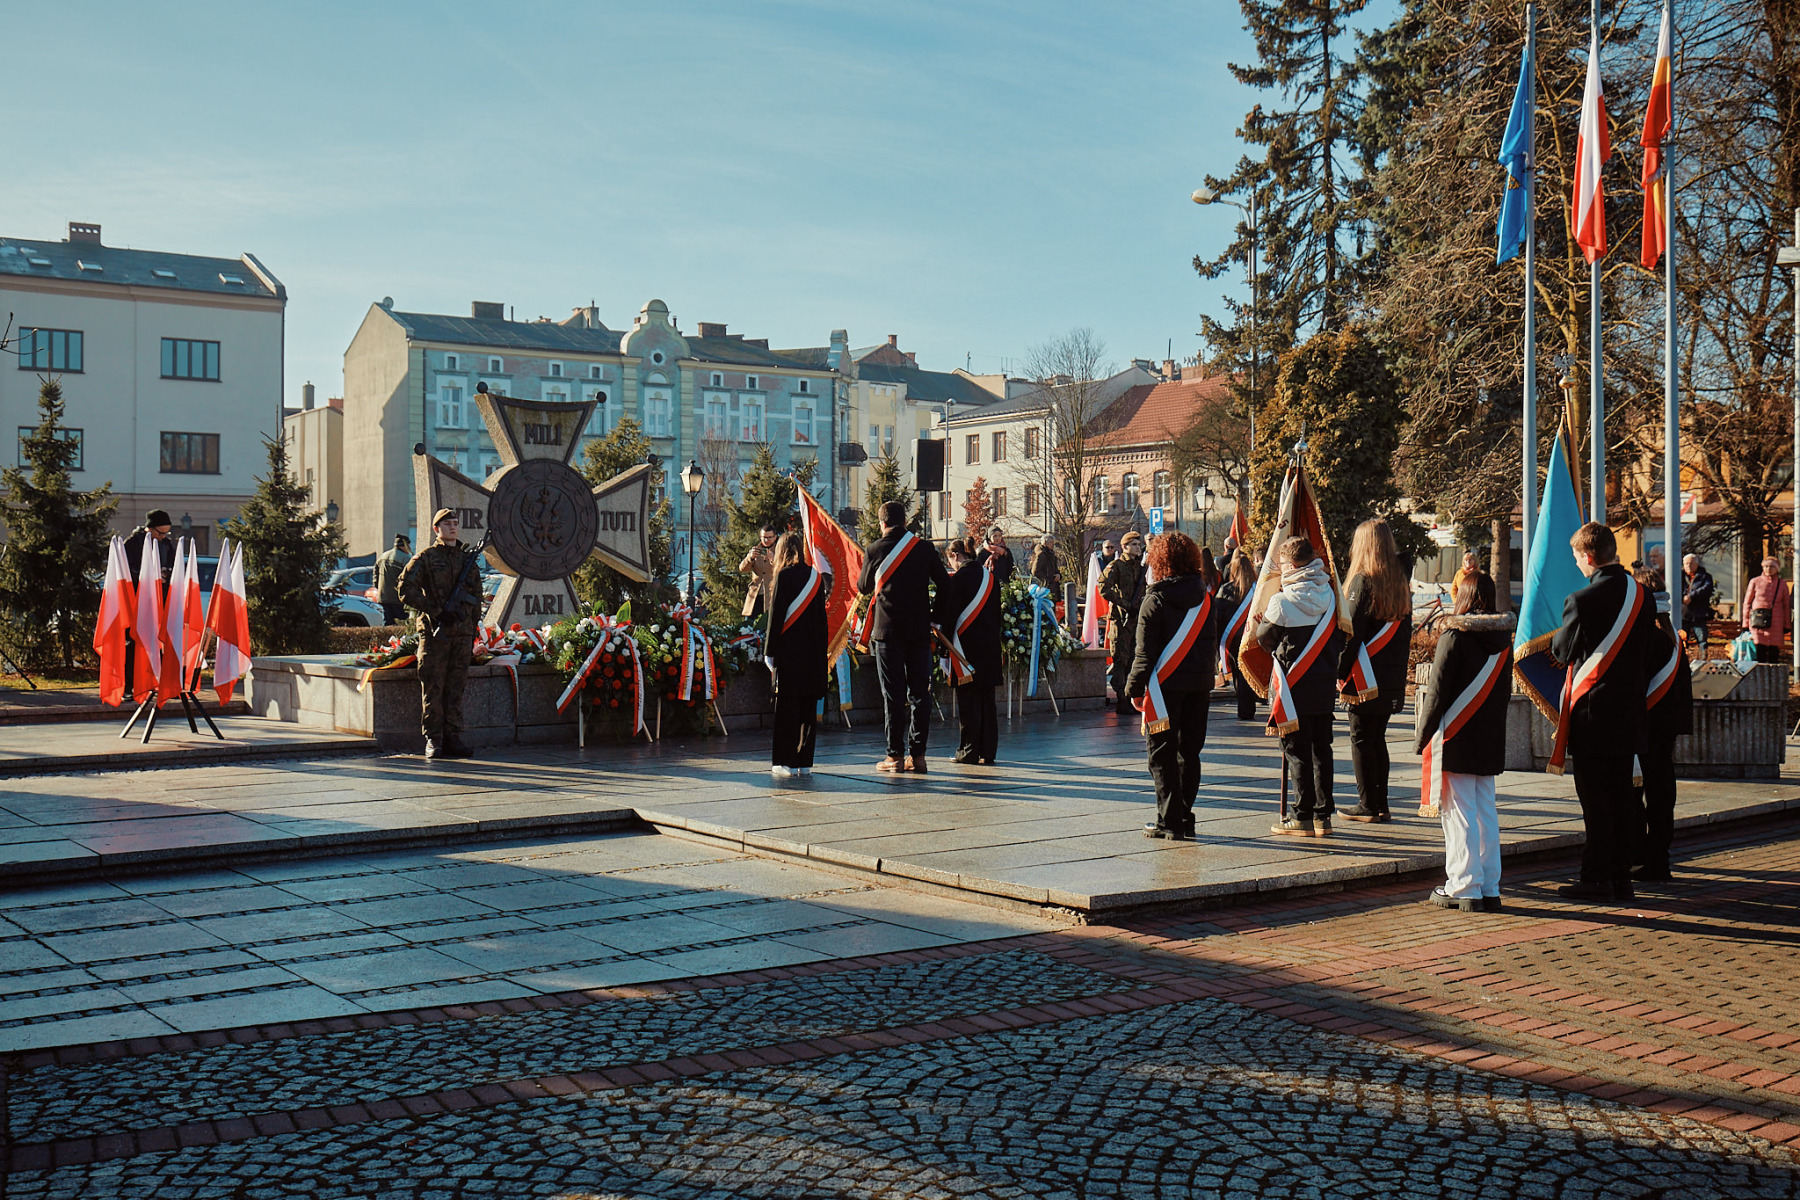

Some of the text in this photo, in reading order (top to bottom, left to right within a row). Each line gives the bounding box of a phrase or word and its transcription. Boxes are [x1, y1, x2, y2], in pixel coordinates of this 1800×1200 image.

[523, 422, 563, 446] MILI
[600, 510, 637, 532] TUTI
[1152, 509, 1161, 528] P
[522, 594, 564, 616] TARI
